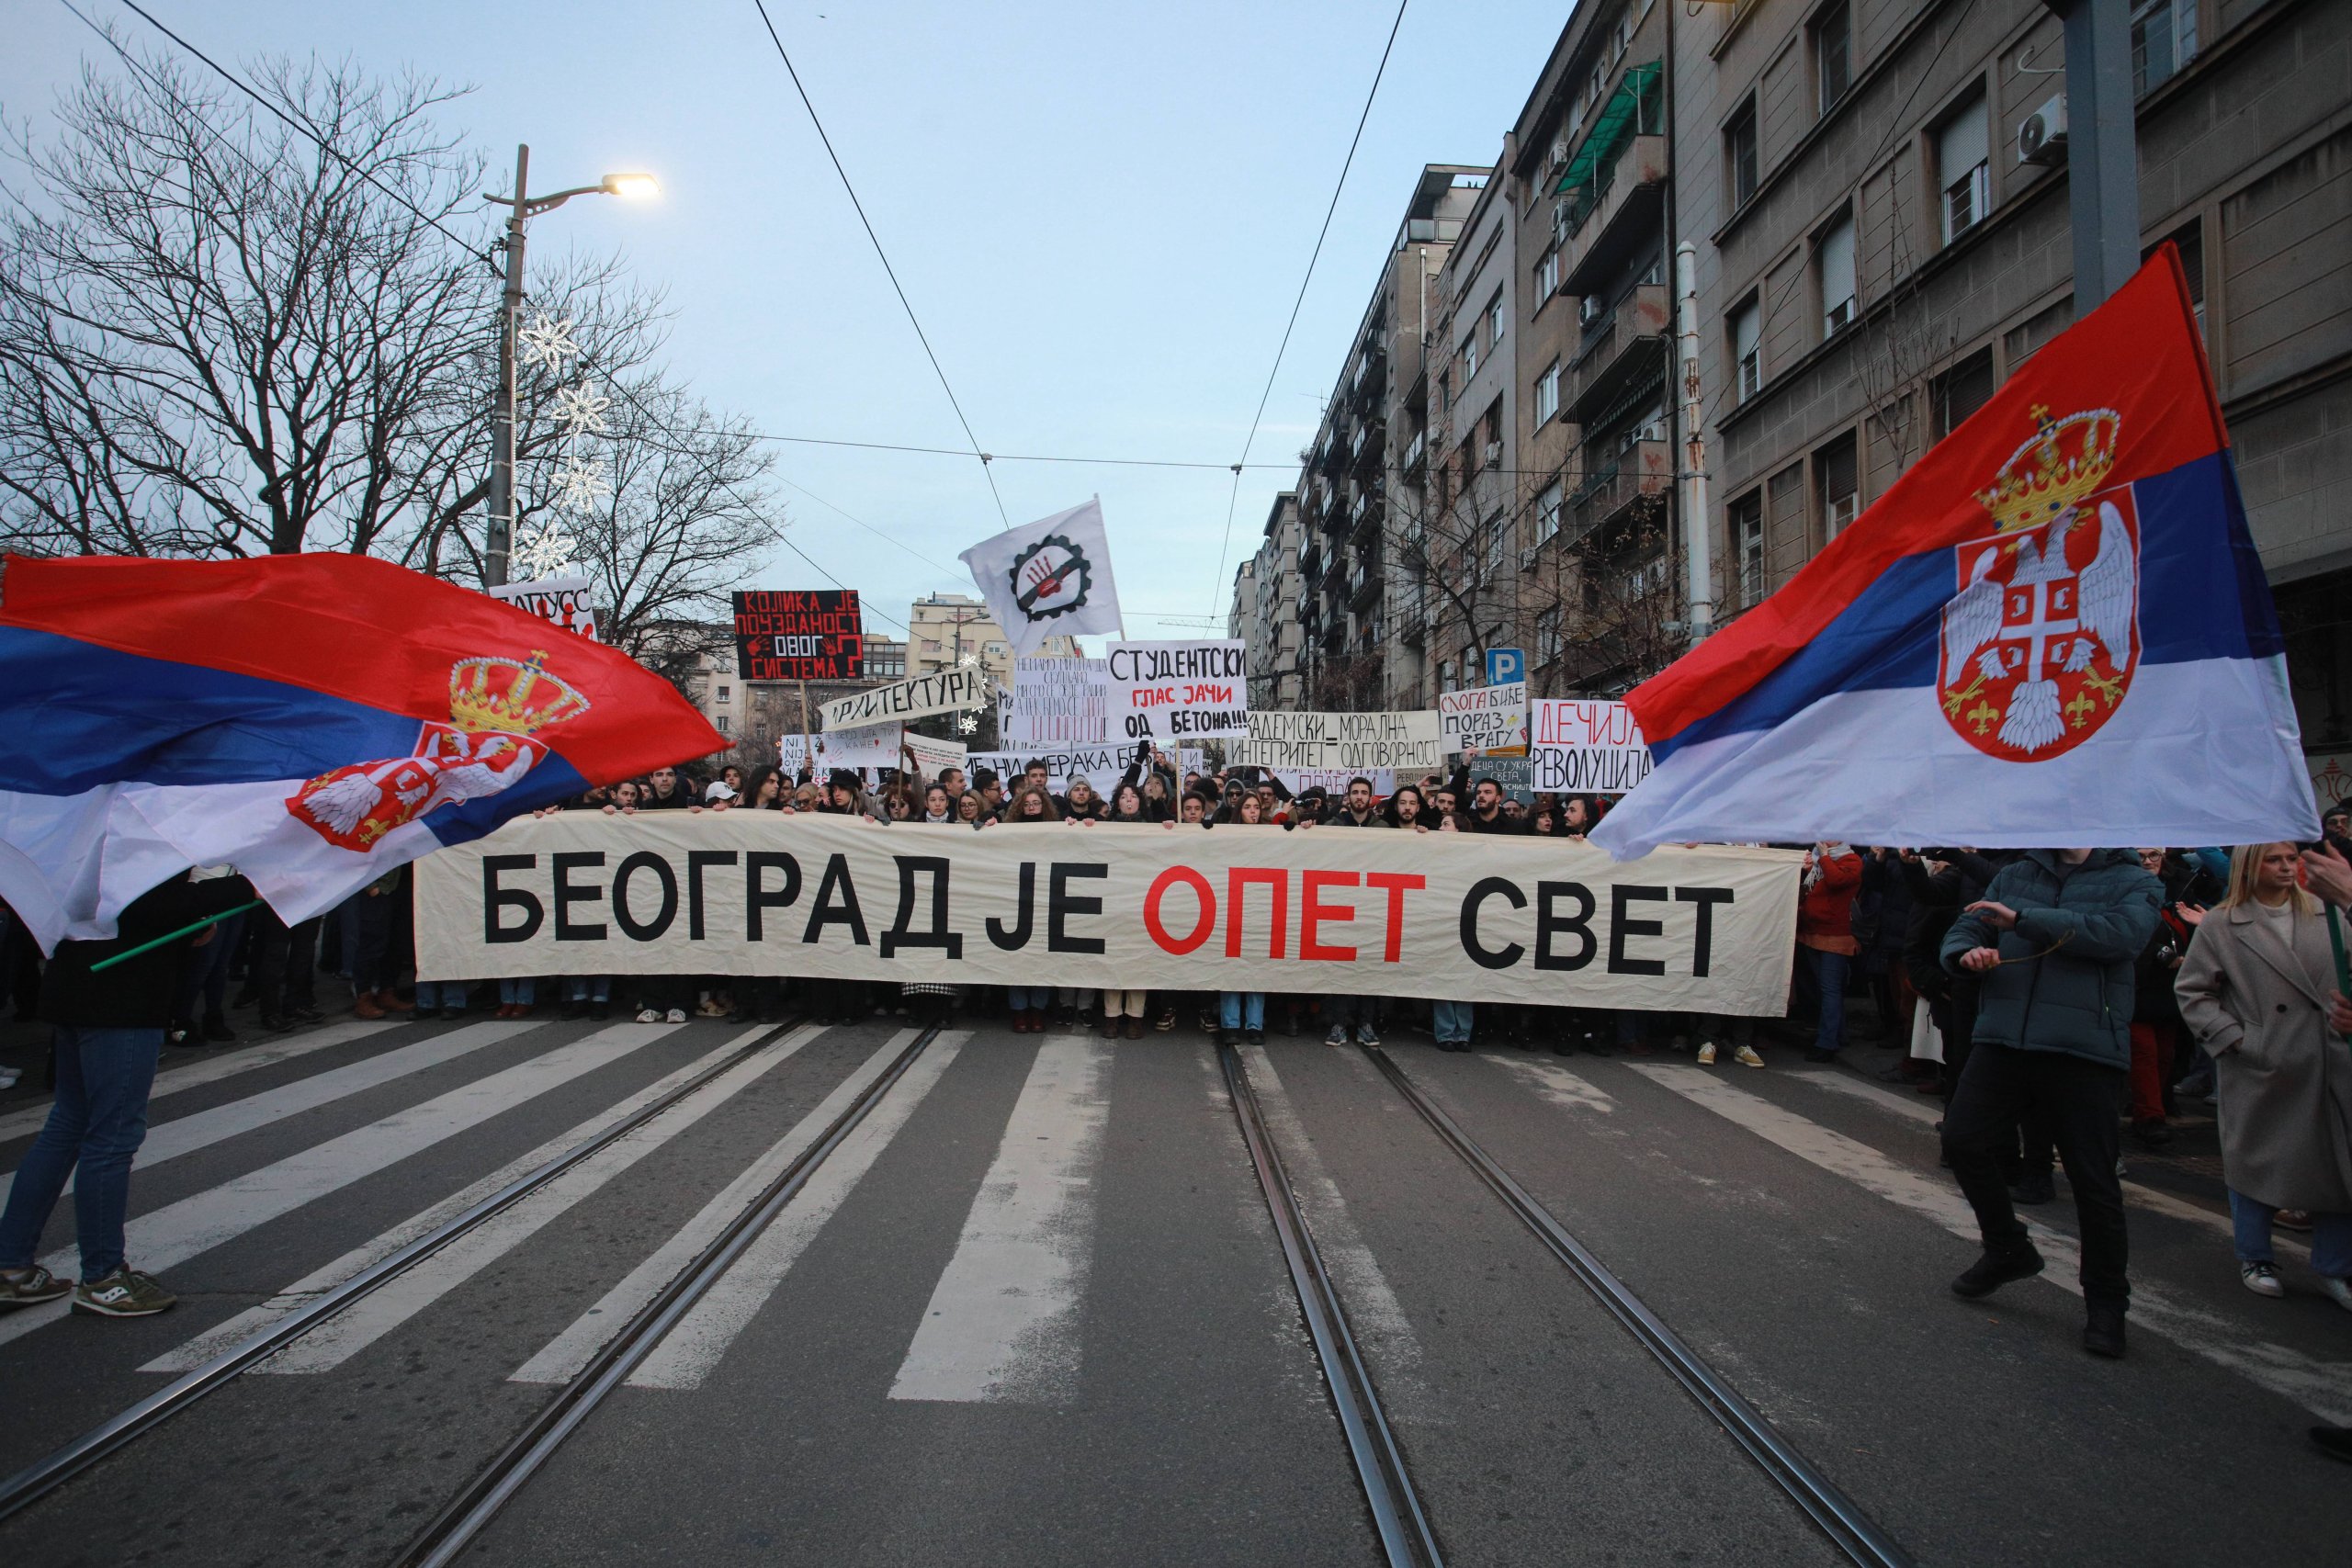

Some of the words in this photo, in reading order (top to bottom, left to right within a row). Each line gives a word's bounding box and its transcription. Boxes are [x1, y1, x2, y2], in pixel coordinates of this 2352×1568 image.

[744, 592, 820, 612] КОЛИКА
[835, 591, 858, 612] ЈЕ
[735, 613, 859, 635] ПОУЗДАНОСТ
[775, 636, 823, 657] ОВОГ
[752, 658, 838, 679] СИСТЕМА
[1110, 648, 1246, 682] СТУДЕНТСКИ
[1496, 653, 1516, 681] P
[1132, 687, 1175, 707] ГЛАС
[1183, 684, 1232, 705] ЈАЧИ
[1441, 692, 1487, 713] СЛОГА
[1490, 686, 1522, 706] БИЋЕ
[1125, 714, 1153, 738] ОД
[1170, 710, 1247, 734] БЕТОНА!!!
[1340, 715, 1408, 741] МОРАЛНА
[1445, 713, 1503, 734] ПОРАЗ
[786, 738, 797, 748] NI
[1462, 728, 1514, 749] ВРАГУ
[1033, 750, 1113, 776] ЕРАКА
[1231, 740, 1325, 768] ИНТЕГРИТЕТ
[1340, 740, 1440, 768] ОДГОВОРНОСТ
[1471, 761, 1493, 771] ДЕЦА
[1496, 761, 1508, 771] СУ
[1532, 748, 1650, 789] РЕВОЛУЦИЈА
[481, 850, 963, 960] БЕОГРАД
[985, 861, 1108, 954] ЈЕ
[1143, 864, 1426, 963] ОПЕТ
[1460, 876, 1735, 977] СВЕТ
